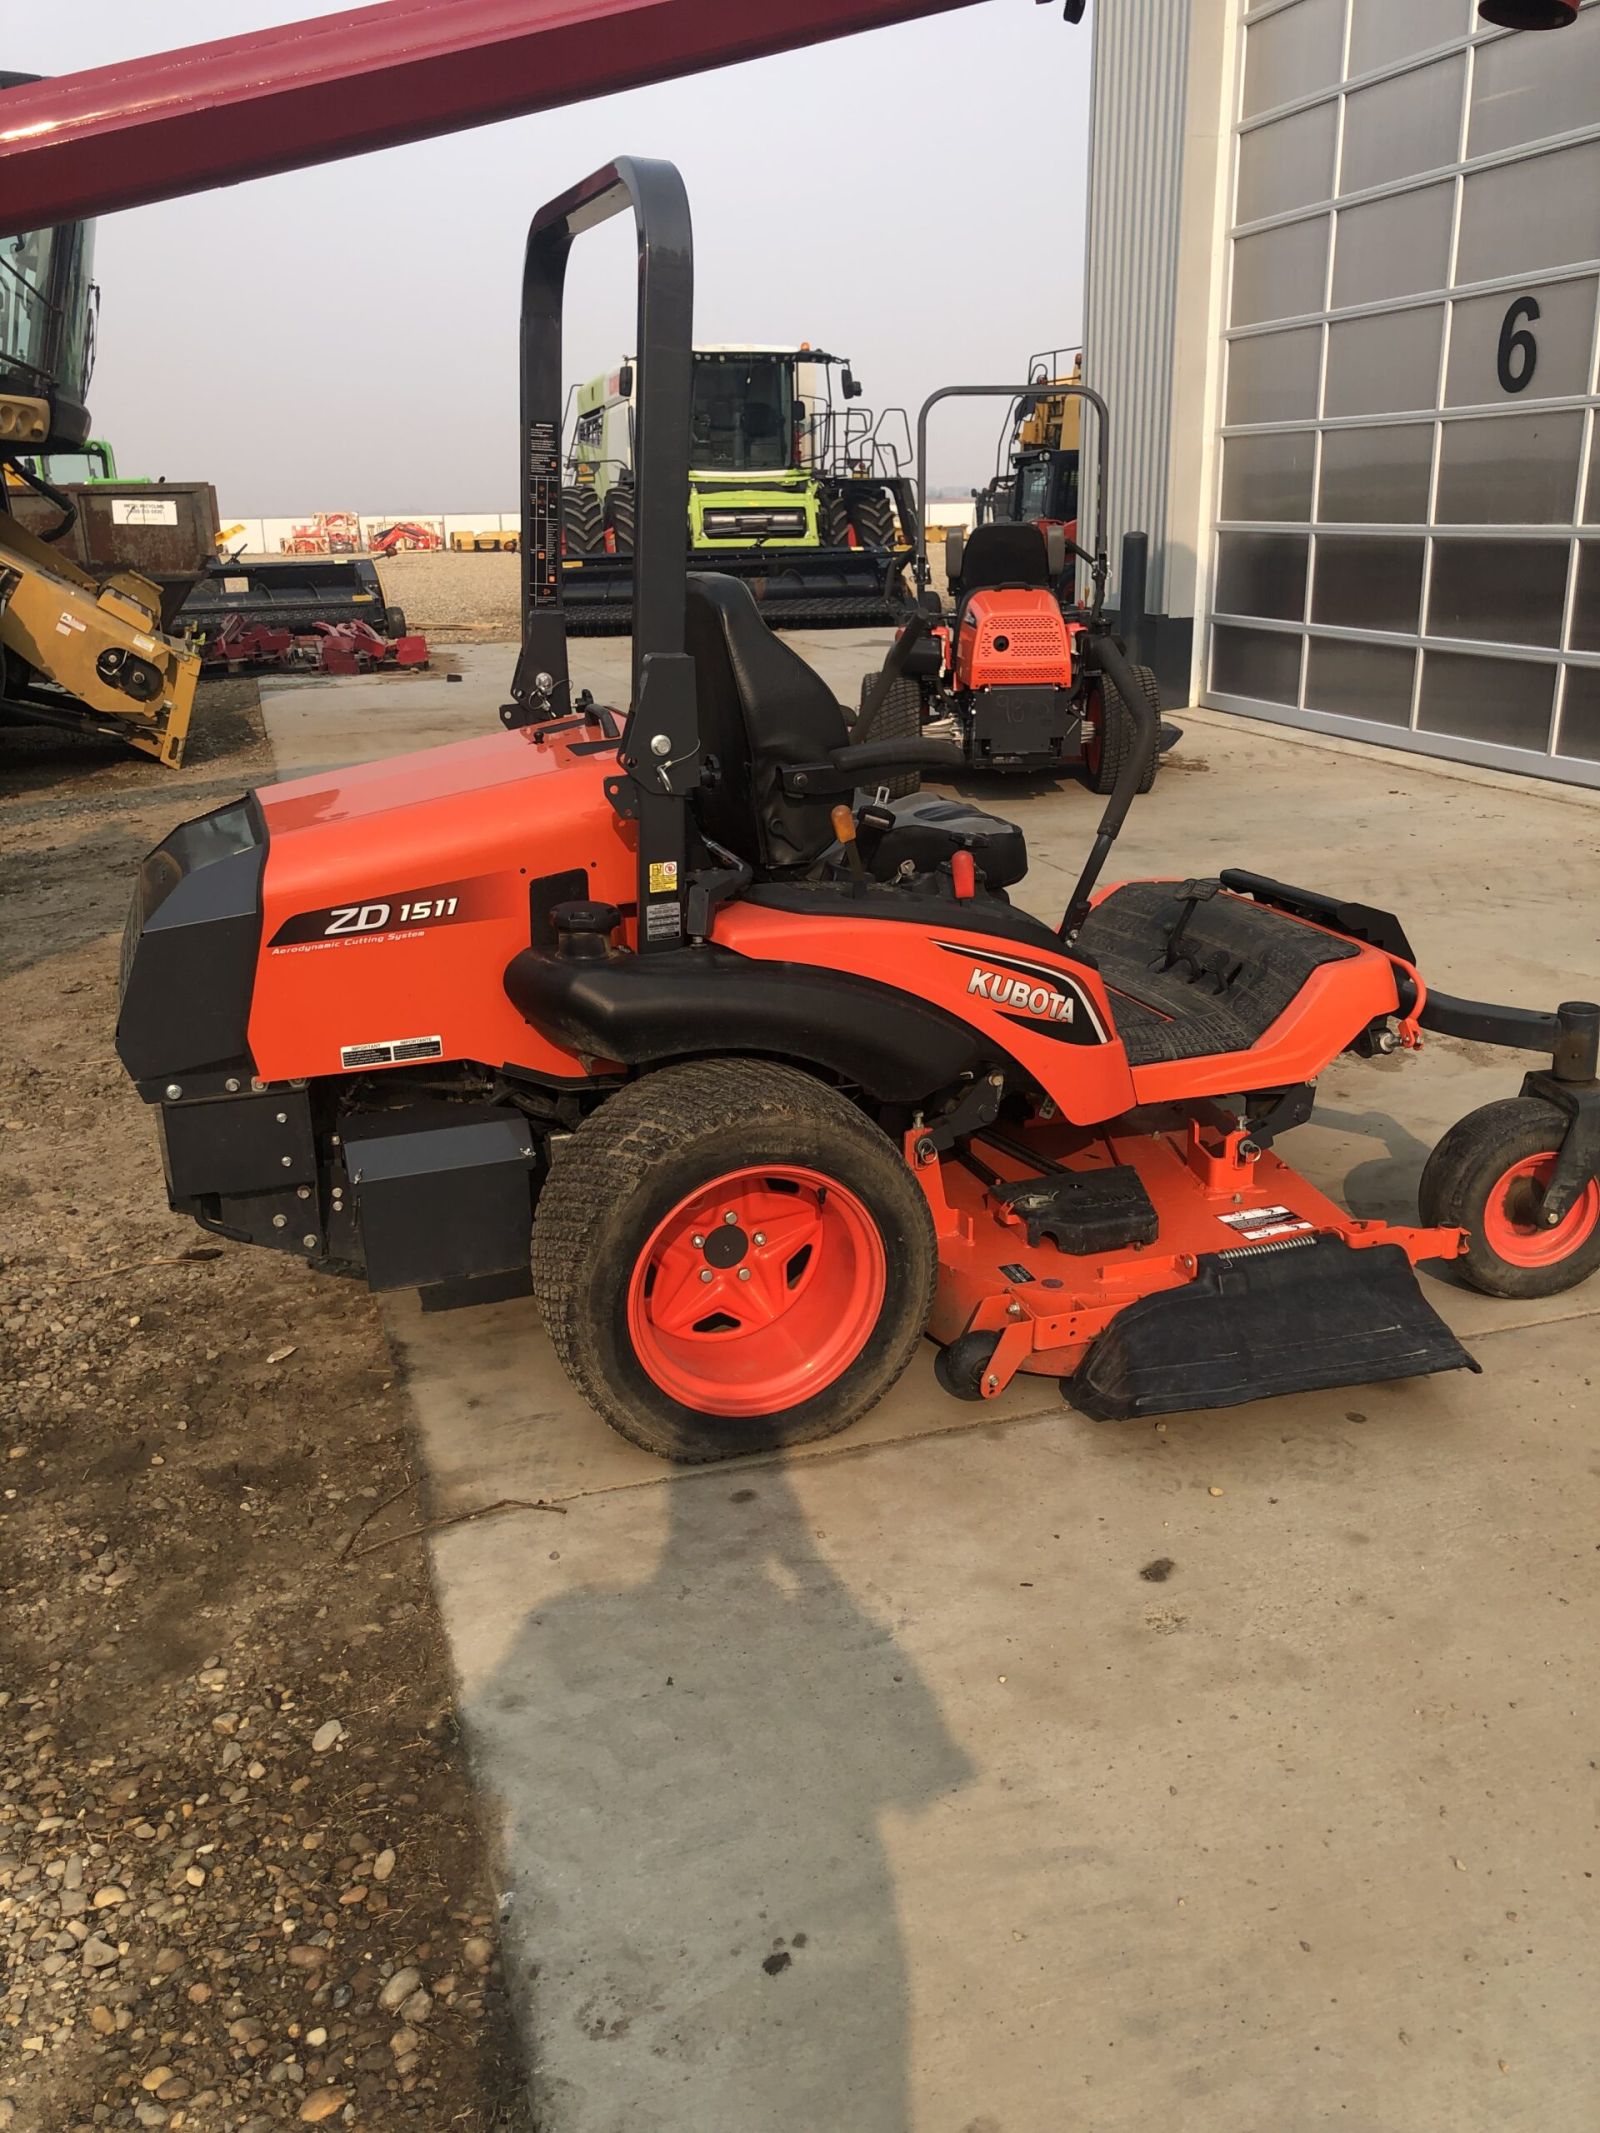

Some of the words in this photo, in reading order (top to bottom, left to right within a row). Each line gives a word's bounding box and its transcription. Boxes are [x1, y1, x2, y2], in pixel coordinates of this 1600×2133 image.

[1497, 296, 1541, 393] 6
[324, 904, 391, 935] ZD
[400, 897, 458, 922] 1511
[271, 940, 340, 955] Aerodynamic
[344, 935, 385, 947] Cutting
[387, 930, 425, 942] System
[967, 968, 1074, 1024] KUBOTA
